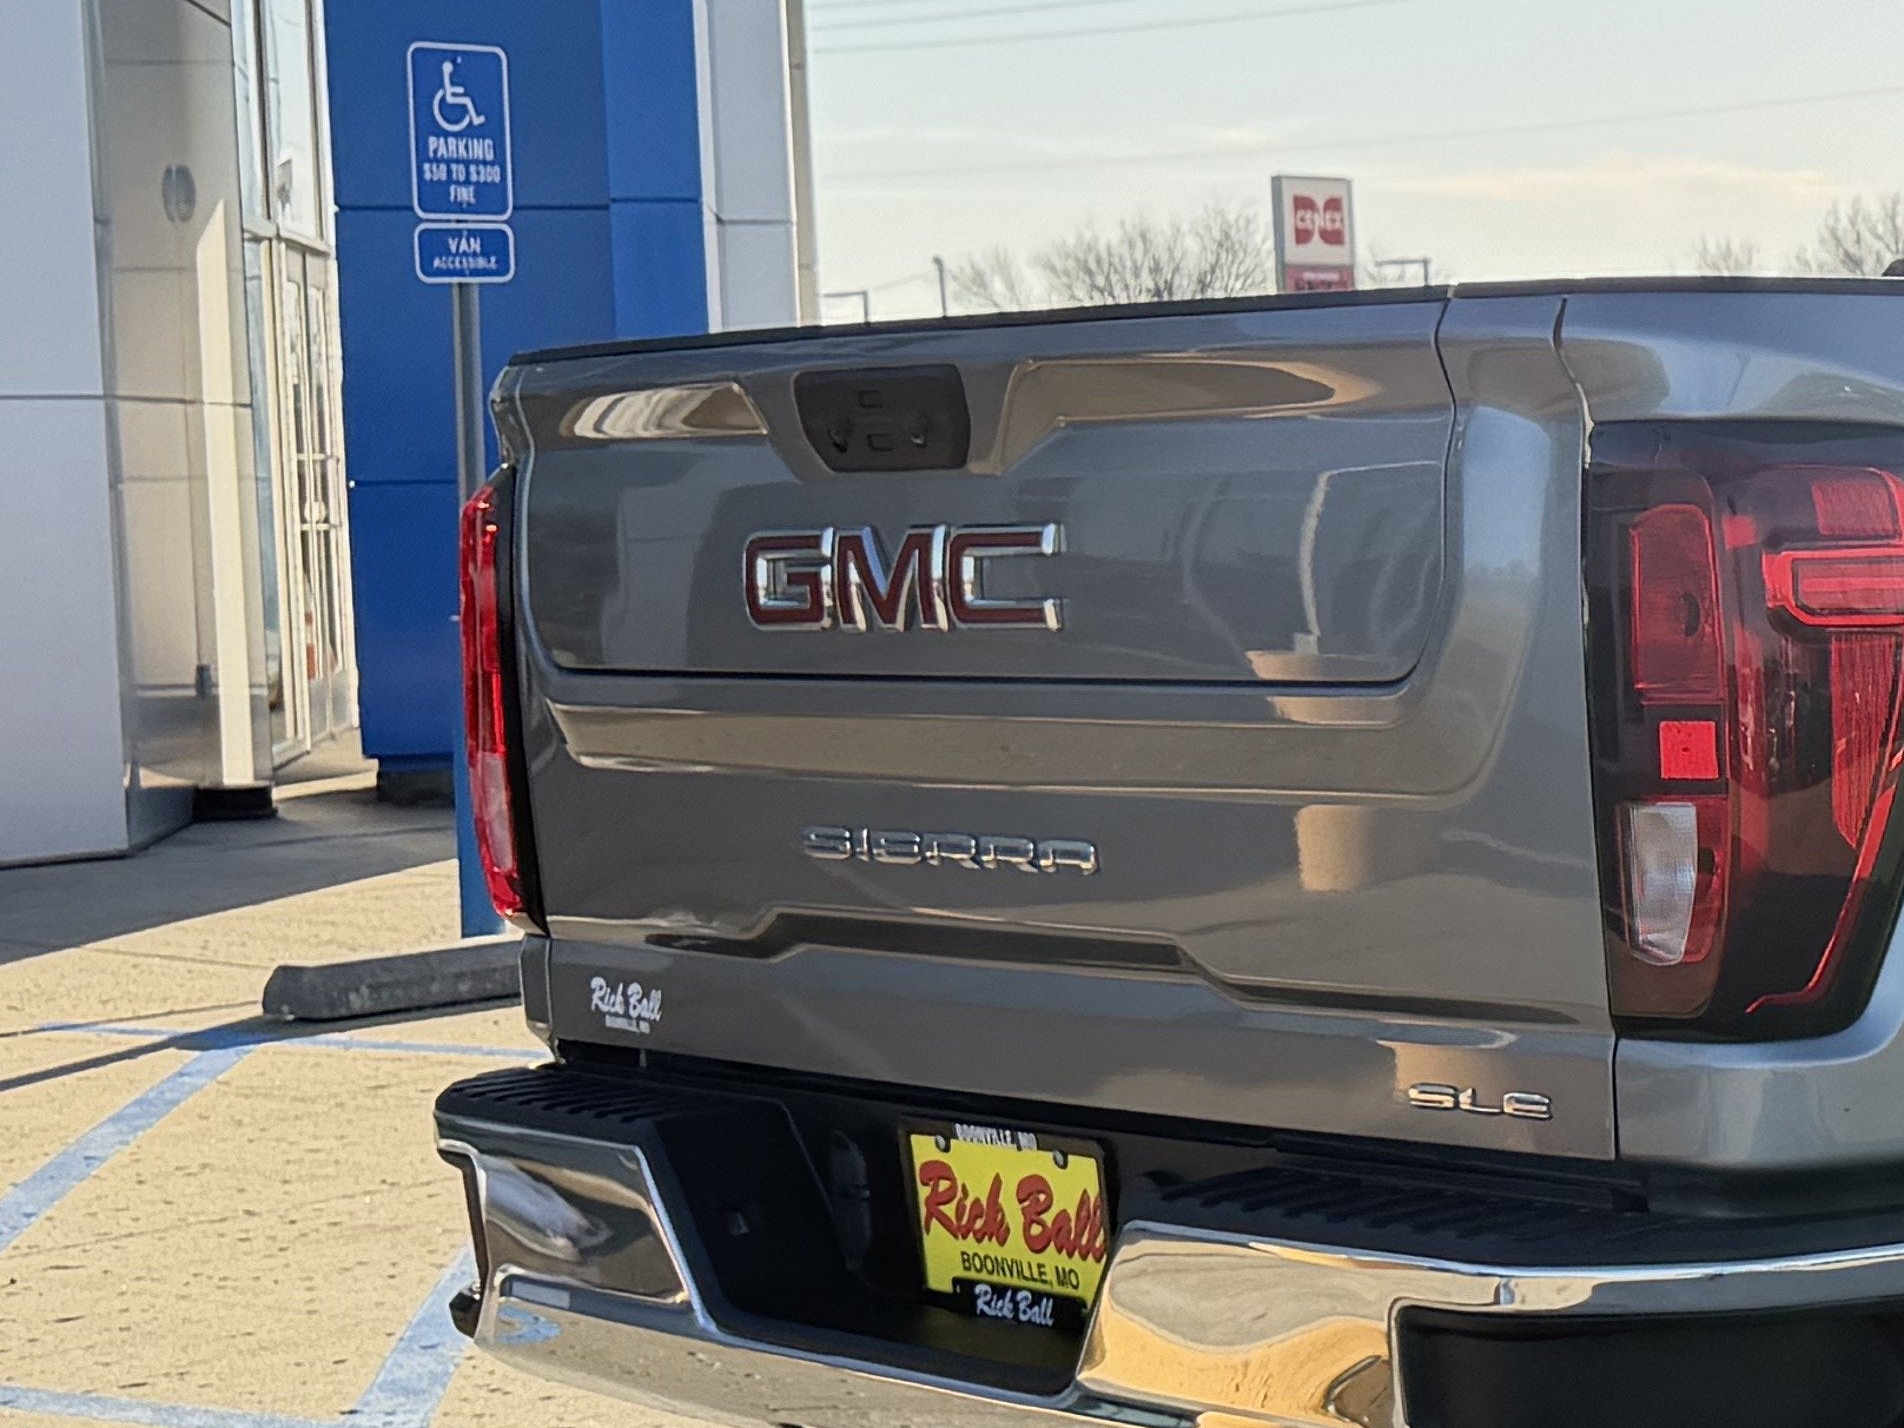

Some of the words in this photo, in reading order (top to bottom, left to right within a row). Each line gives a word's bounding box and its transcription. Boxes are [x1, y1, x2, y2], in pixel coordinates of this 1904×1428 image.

[428, 135, 495, 162] PARKING
[451, 164, 466, 183] TO
[449, 184, 476, 204] FINE
[448, 236, 481, 254] VAN
[742, 523, 1067, 633] GMC
[801, 825, 1100, 876] SIERRA
[1408, 1083, 1553, 1120] SLE
[919, 1159, 1011, 1248] Rick
[1016, 1174, 1108, 1264] Ball
[960, 1250, 1053, 1288] BOONVILLE,
[1055, 1264, 1081, 1291] MO
[974, 1283, 1015, 1320] Rick
[1016, 1290, 1055, 1327] Ball
